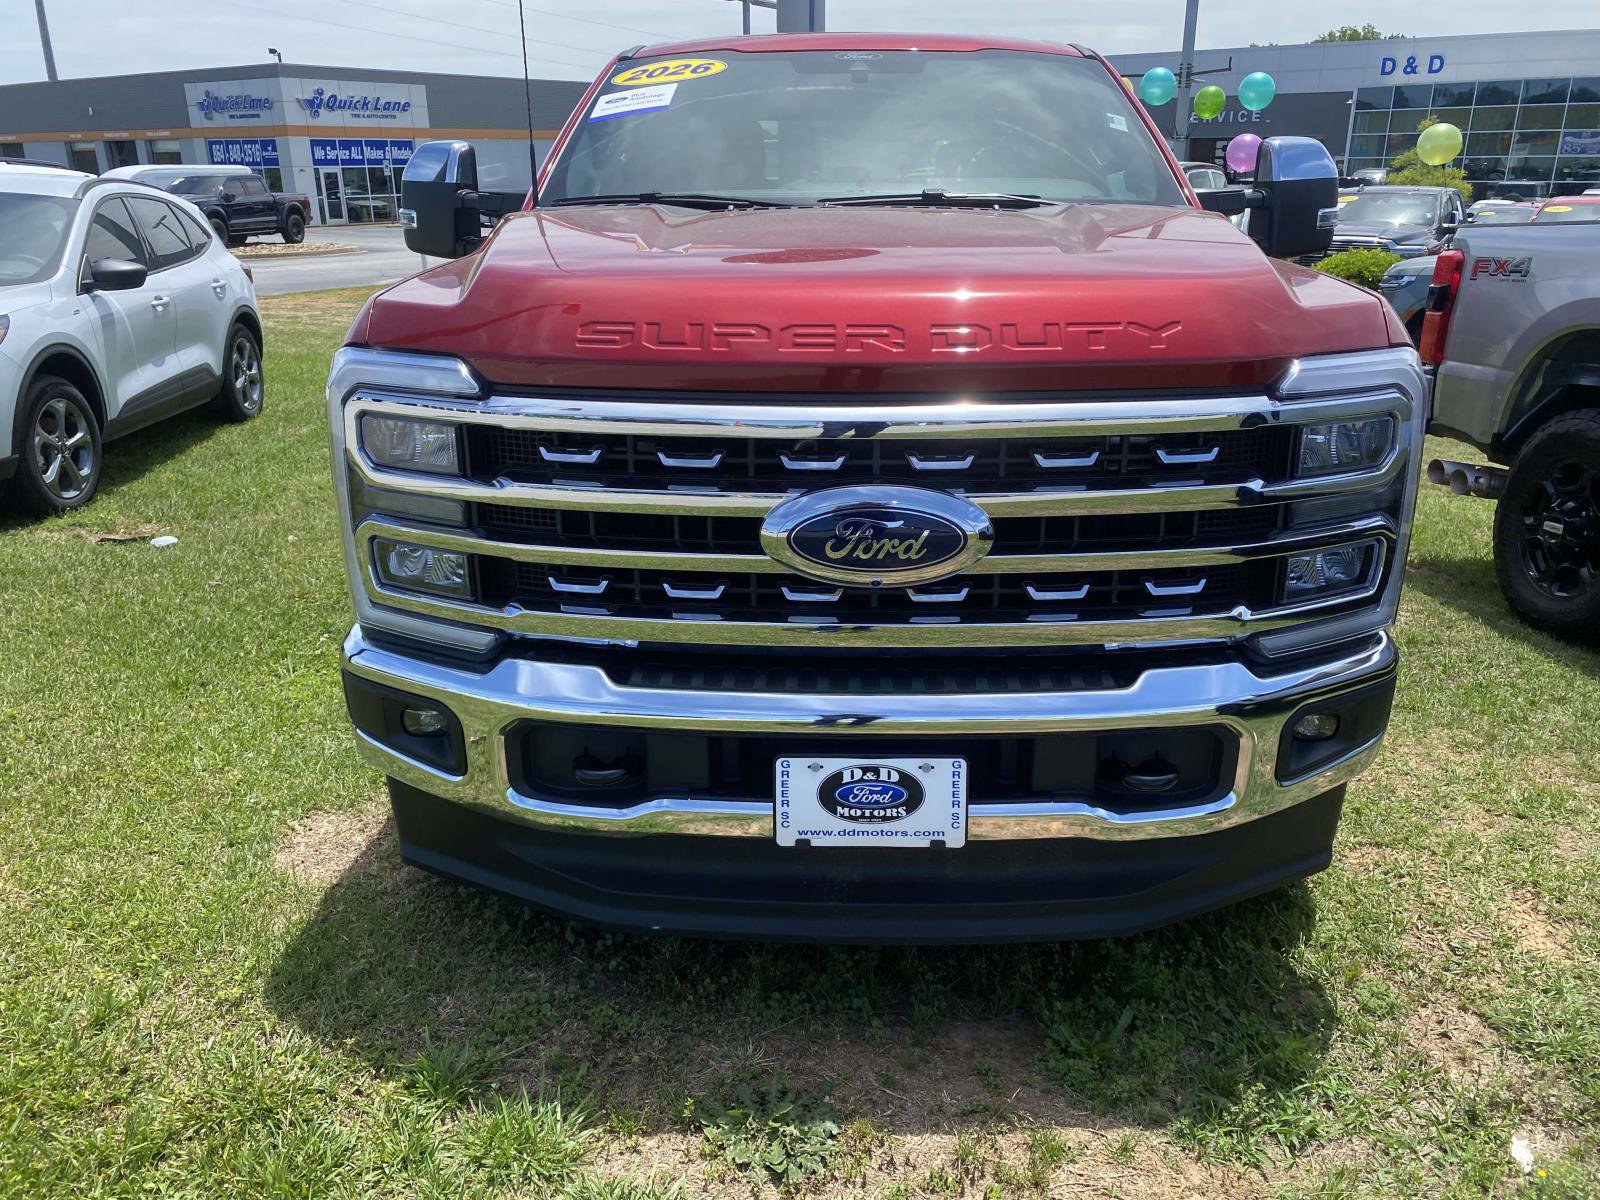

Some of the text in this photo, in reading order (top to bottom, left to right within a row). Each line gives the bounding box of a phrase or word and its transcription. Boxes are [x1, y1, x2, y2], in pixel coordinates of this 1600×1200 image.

[622, 62, 716, 82] 2026
[326, 94, 410, 112] Quick Lane
[314, 146, 325, 160] We
[326, 146, 350, 160] Service
[351, 146, 363, 160] ALL
[364, 147, 384, 160] Makes
[1470, 256, 1532, 280] FX4
[575, 321, 1183, 353] SUPER DUTY
[824, 517, 929, 562] Ford
[841, 767, 900, 784] D&D
[780, 760, 791, 828] GREER SC
[849, 785, 893, 804] Ford
[951, 760, 962, 829] GREER SC
[836, 806, 907, 817] MOTORS
[797, 828, 946, 838] www.ddmotors.com
